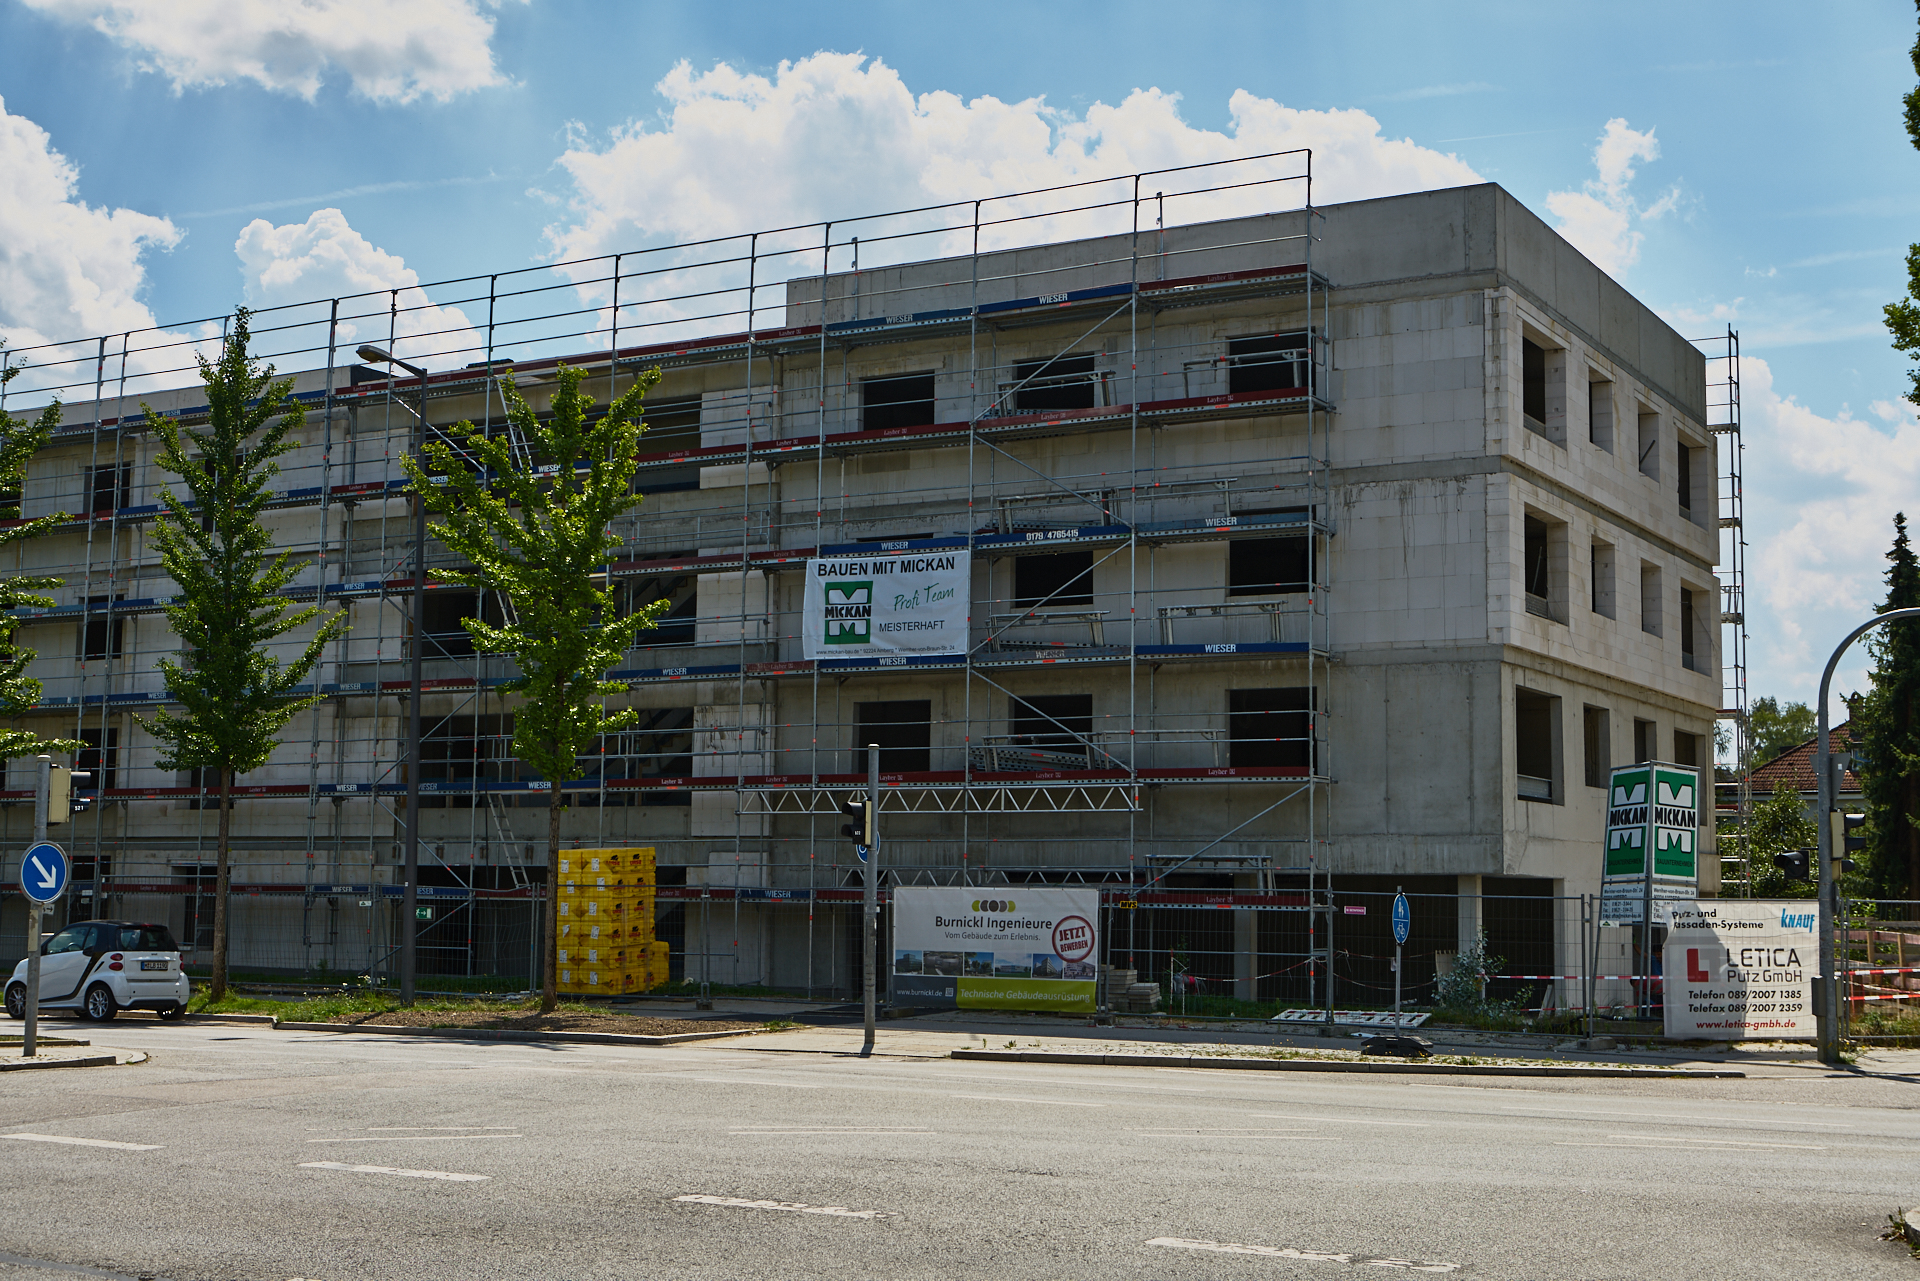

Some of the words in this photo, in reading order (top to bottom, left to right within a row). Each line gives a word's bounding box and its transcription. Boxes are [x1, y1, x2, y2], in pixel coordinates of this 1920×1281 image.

[1039, 293, 1068, 305] WIESER
[886, 315, 913, 324] WIESER
[538, 464, 561, 474] WIESER
[1205, 517, 1237, 526] WIESER
[880, 541, 909, 551] WIESER
[818, 563, 868, 577] BAUEN
[872, 560, 897, 575] MIT
[900, 556, 955, 573] MICKAN
[343, 582, 365, 593] WIESER
[153, 597, 173, 606] WIESER
[894, 590, 920, 611] Profi
[924, 582, 954, 604] Team
[824, 605, 872, 619] MICKAN
[879, 619, 945, 633] MEISTERHAFT
[1204, 643, 1235, 653] WIESER
[1034, 650, 1064, 659] WIESER
[880, 658, 907, 666] WIESER
[662, 667, 688, 676] WIESER
[340, 682, 362, 691] WIESER
[147, 692, 167, 700] WIESER
[336, 783, 358, 792] WIESER
[527, 781, 552, 790] WIESER
[1609, 806, 1649, 827] MICKAN
[1655, 806, 1697, 828] MICKAN
[1656, 857, 1693, 868] BAUUNTERNEHMEN
[332, 886, 353, 894] WIESER
[764, 889, 790, 899] WIESER
[1689, 888, 1696, 896] 24
[1120, 900, 1138, 909] MVS
[1697, 908, 1717, 918] und
[935, 915, 984, 929] Burnickl
[986, 916, 1053, 932] Ingenieure
[945, 931, 959, 942] Vom
[961, 931, 992, 943] Gebäude
[993, 934, 1009, 943] zum
[1010, 932, 1041, 942] Erlebnis.
[1058, 925, 1087, 942] JETZT
[1059, 939, 1089, 953] BEWERBEN
[1726, 948, 1802, 968] LETICA
[1727, 969, 1760, 983] Putz
[1763, 969, 1803, 983] GmbH
[896, 989, 943, 998] www.burnickl.de
[960, 988, 1005, 1000] Technische
[1005, 989, 1091, 1004] Gebäudeausrüstung
[1689, 989, 1726, 1000] Telefon
[1727, 989, 1777, 1001] 089/2007
[1779, 989, 1803, 999] 1385
[1689, 1003, 1726, 1013] Telefax
[1727, 1003, 1777, 1015] 089/2007
[1779, 1003, 1803, 1012] 2359
[1696, 1019, 1797, 1031] www.letica-gmbh.de
